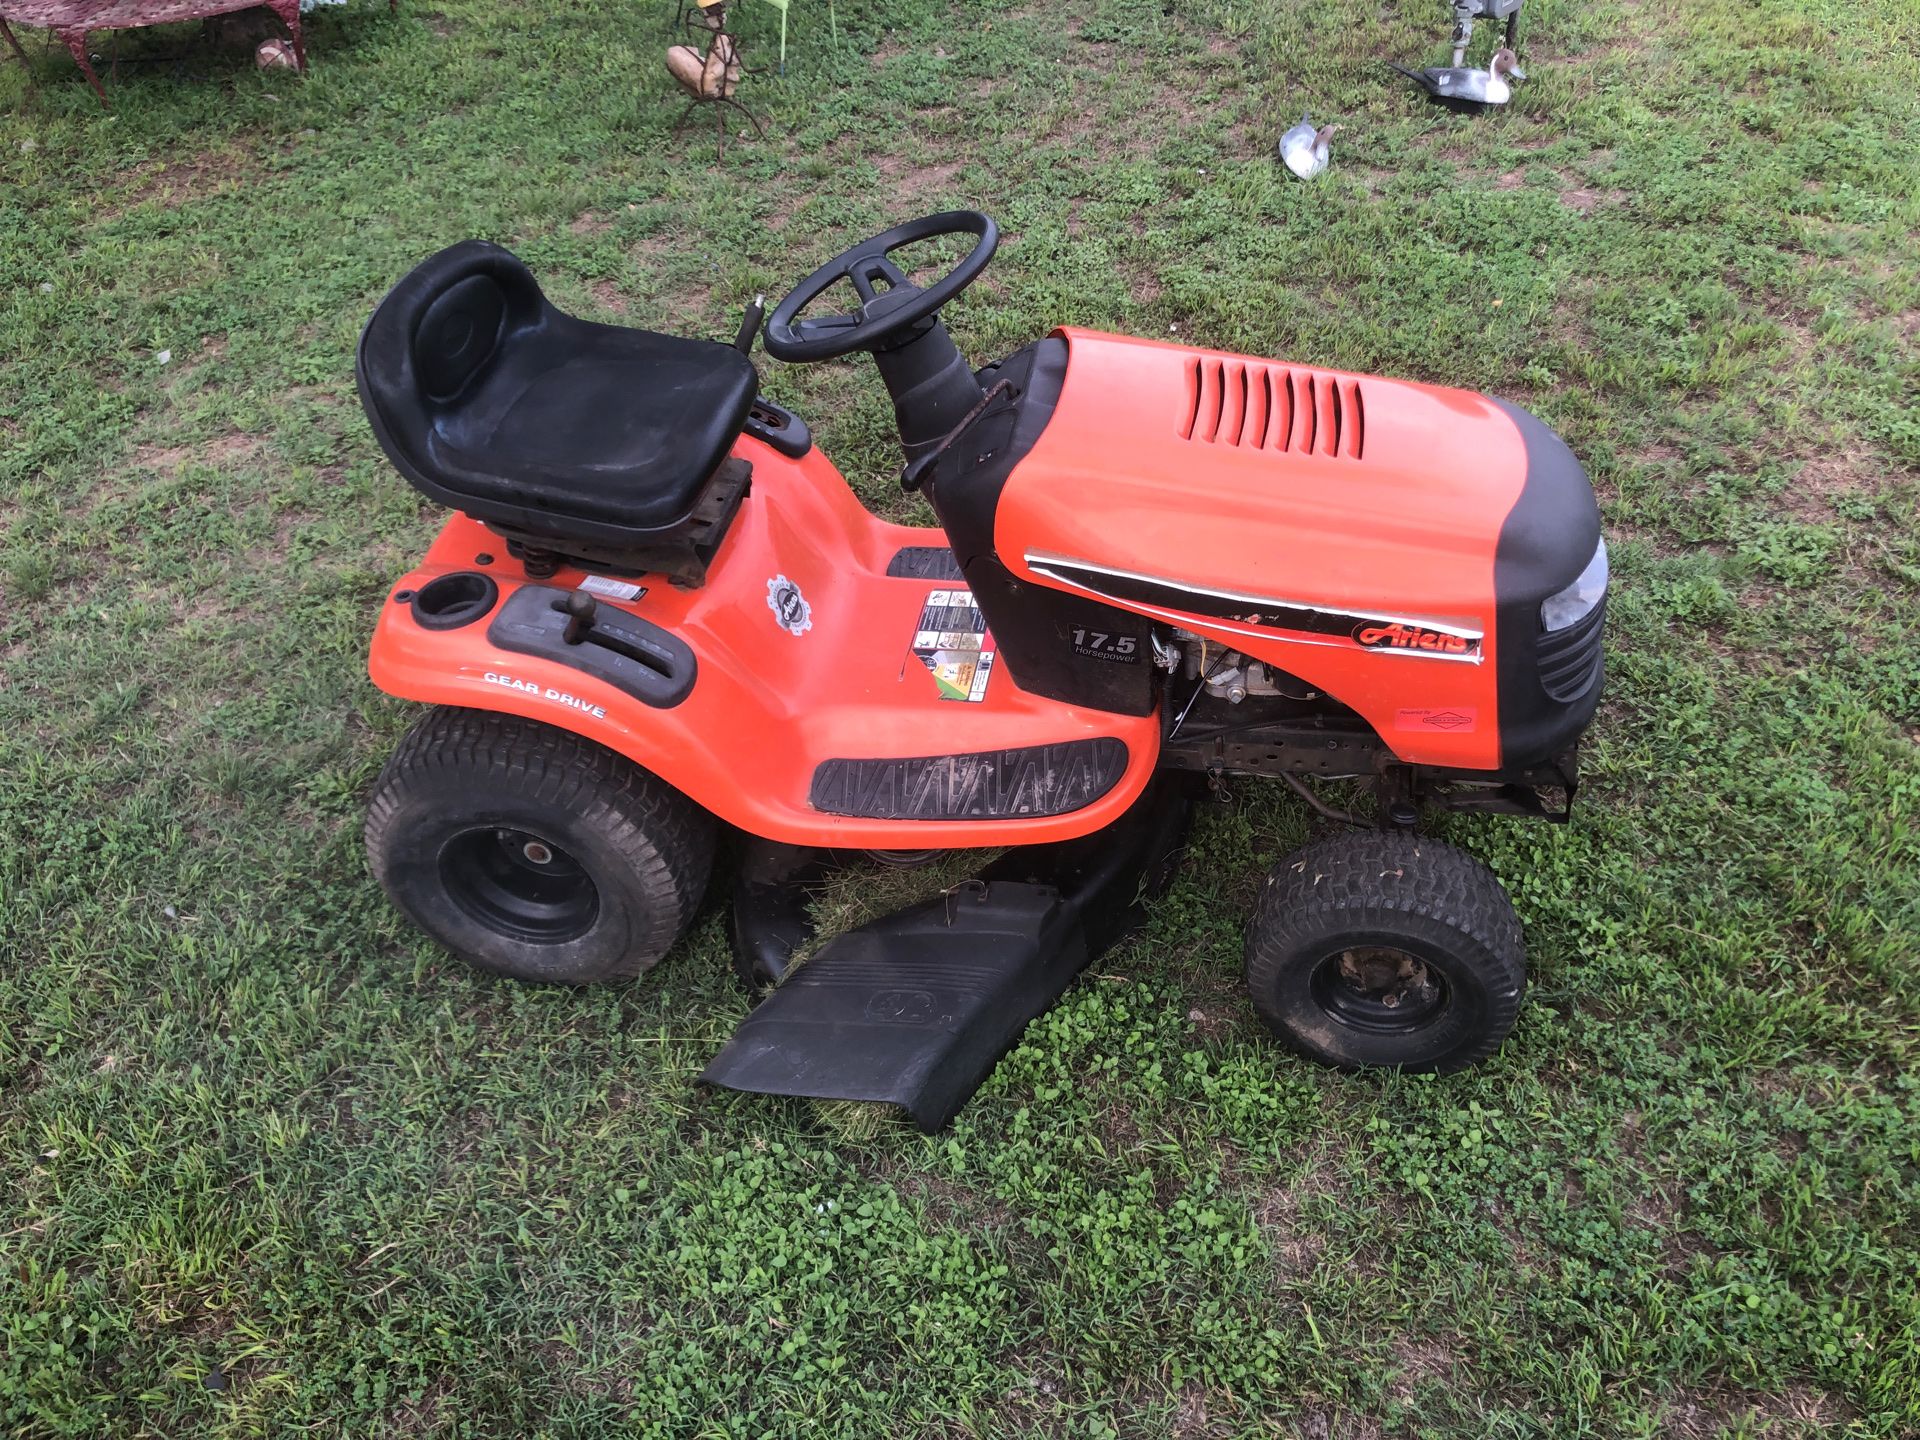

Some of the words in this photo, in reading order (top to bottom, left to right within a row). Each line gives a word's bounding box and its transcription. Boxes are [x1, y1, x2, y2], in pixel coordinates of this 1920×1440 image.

[1073, 629, 1137, 654] 17.5
[1360, 622, 1468, 653] Ariens
[1075, 645, 1136, 663] Horsepower
[483, 672, 539, 695] GEAR
[544, 688, 608, 719] DRIVE
